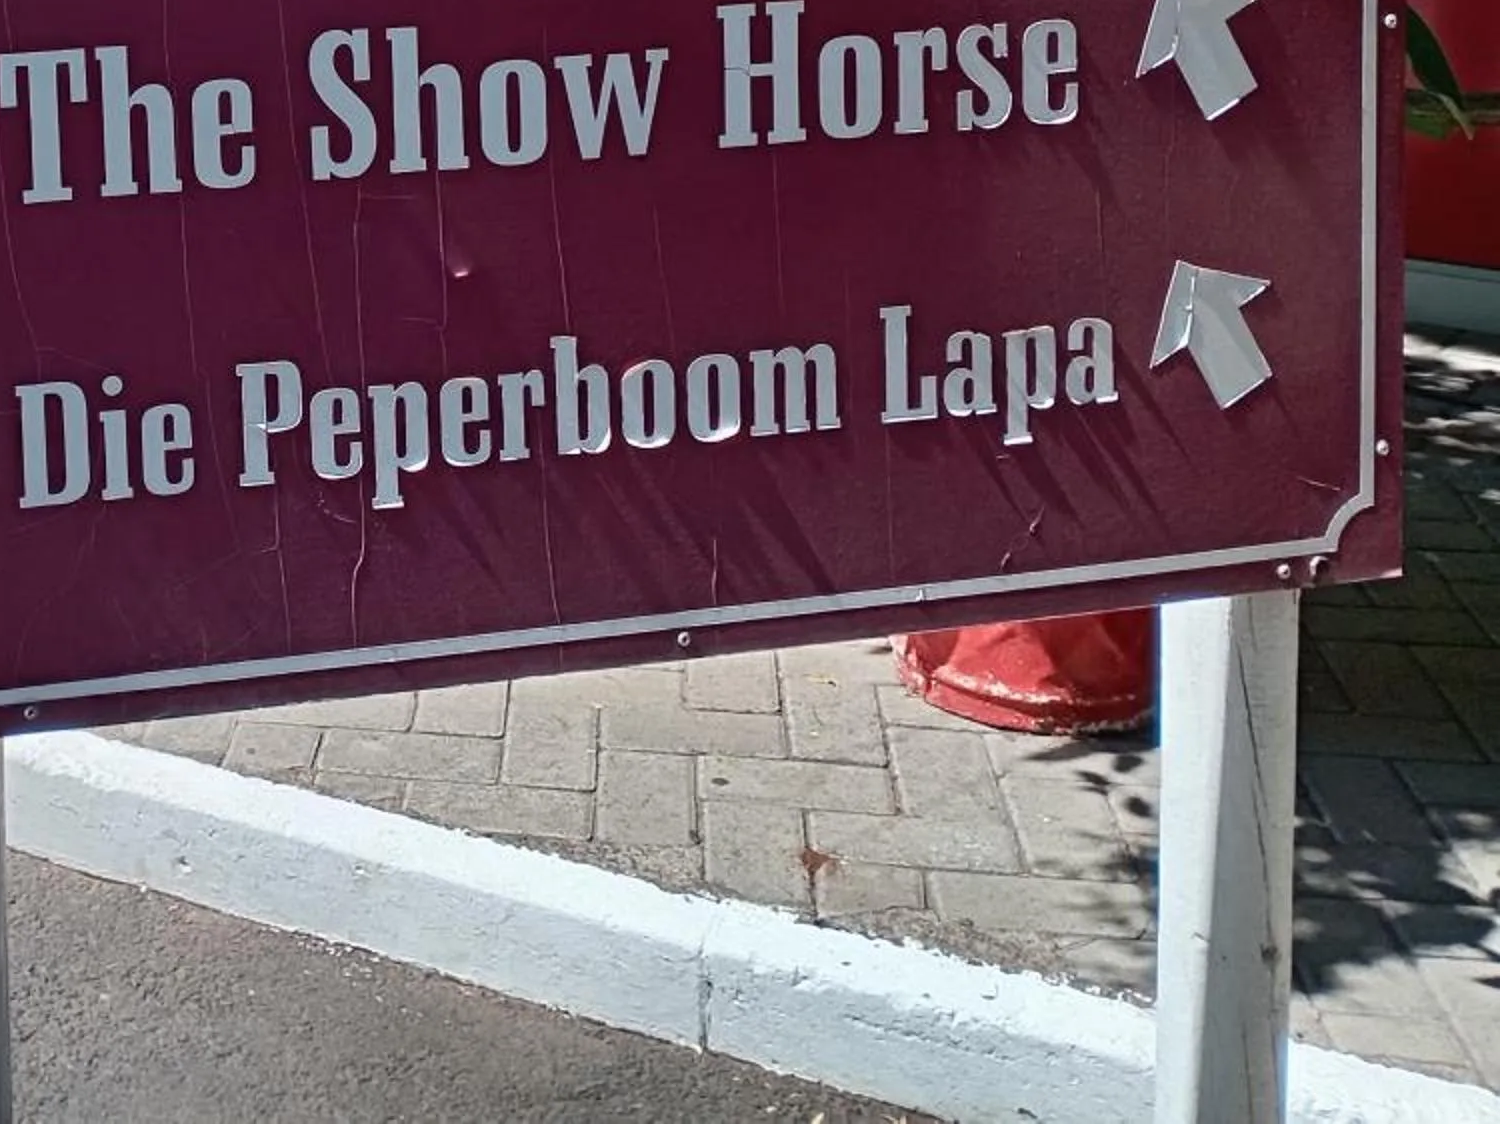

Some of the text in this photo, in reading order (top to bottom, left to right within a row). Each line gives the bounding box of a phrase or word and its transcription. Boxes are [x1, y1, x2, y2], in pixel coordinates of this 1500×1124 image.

[309, 26, 669, 181] Show
[716, 0, 1079, 149] Horse
[15, 305, 1119, 510] Die Peperboom Lapa
